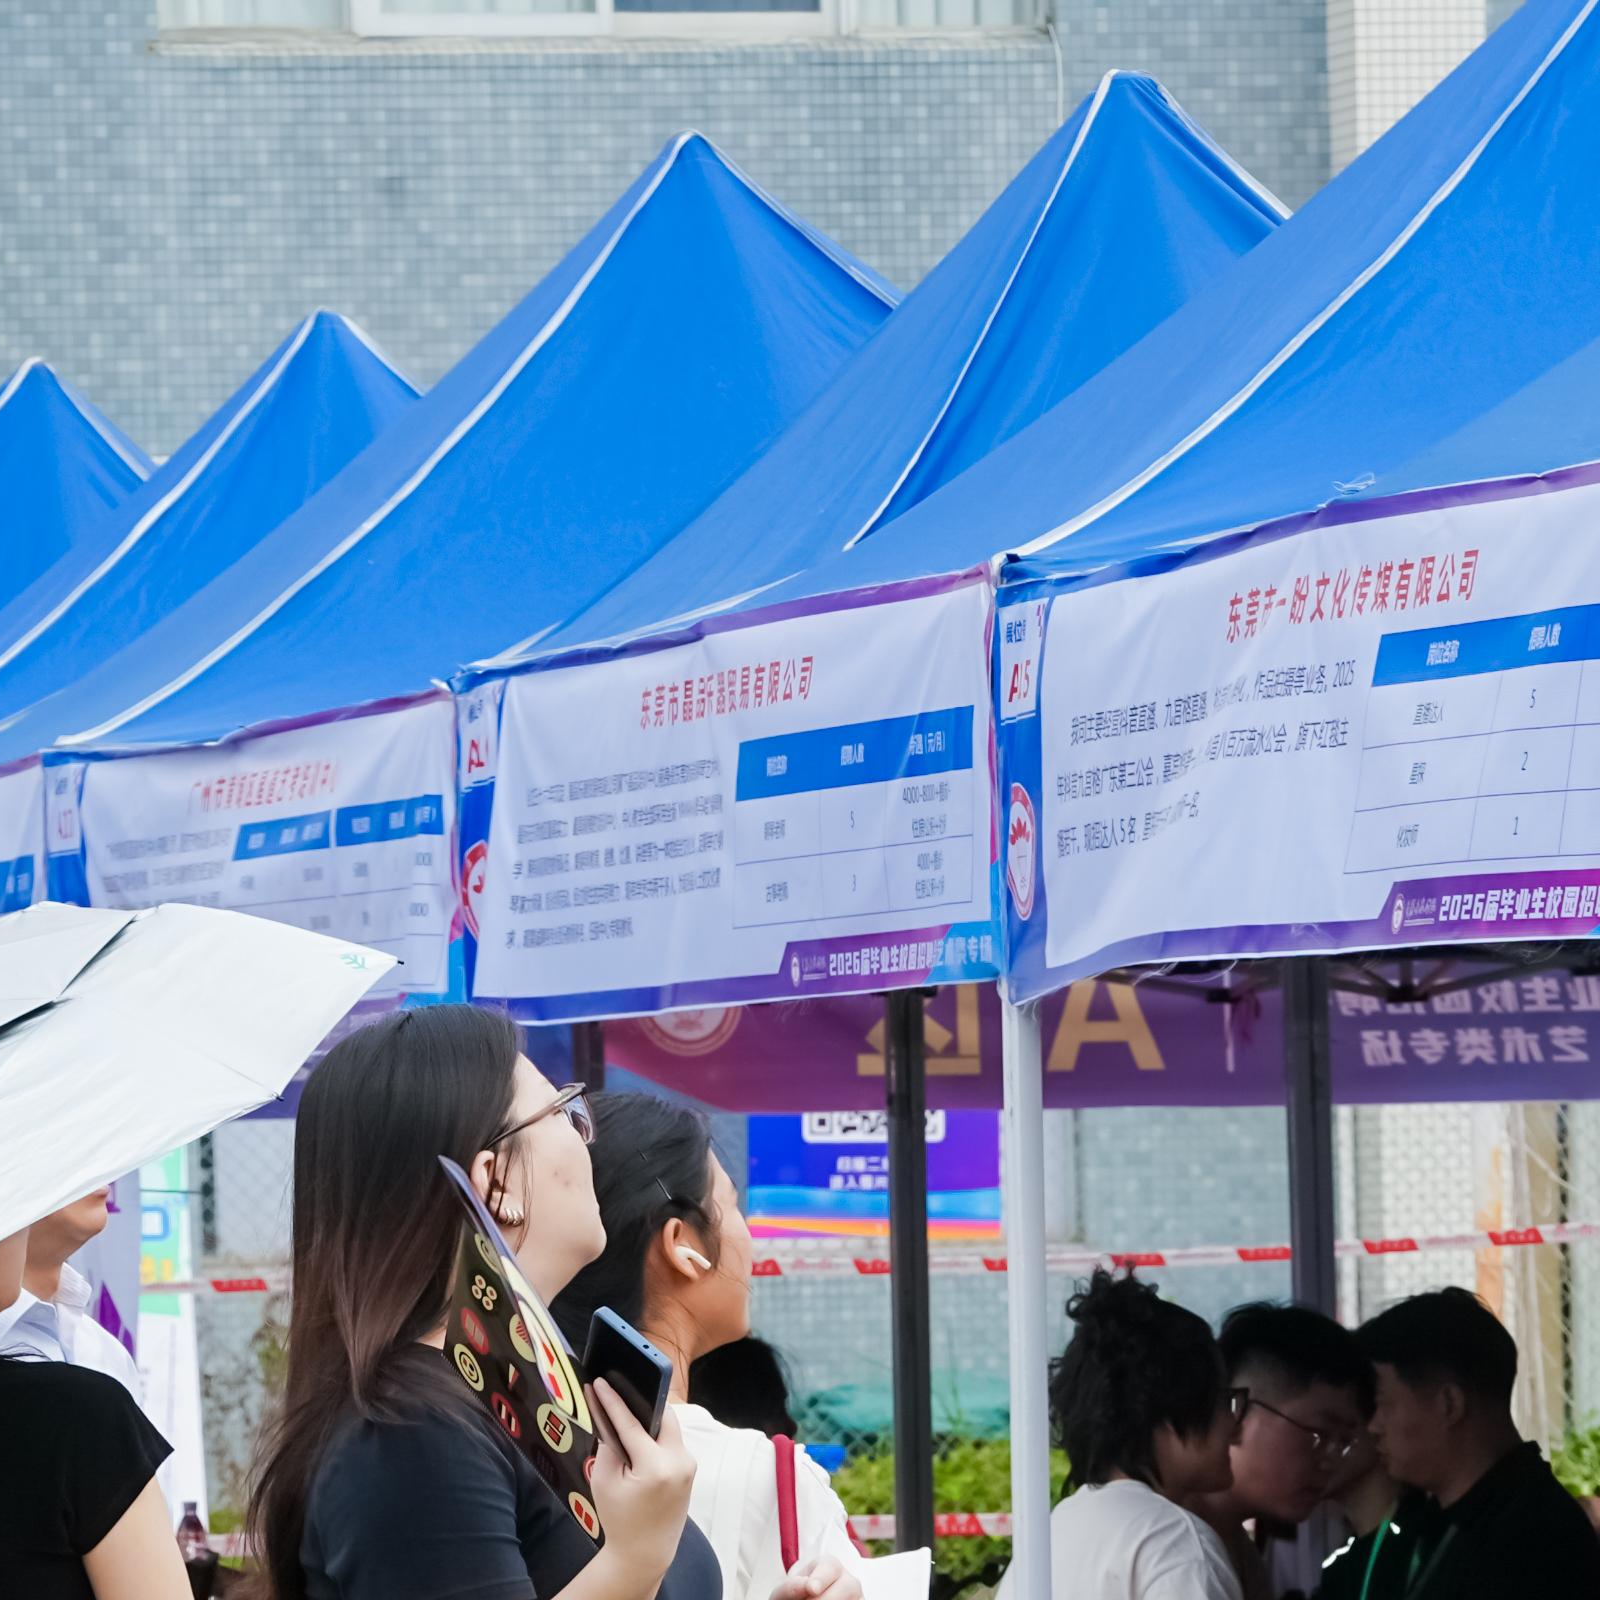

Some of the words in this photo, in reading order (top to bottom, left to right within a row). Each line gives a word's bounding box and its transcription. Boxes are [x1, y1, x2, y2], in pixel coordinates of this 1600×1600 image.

[1530, 689, 1536, 708] 5
[1521, 752, 1528, 771] 2
[850, 810, 855, 829] 5
[1513, 816, 1518, 835] 1
